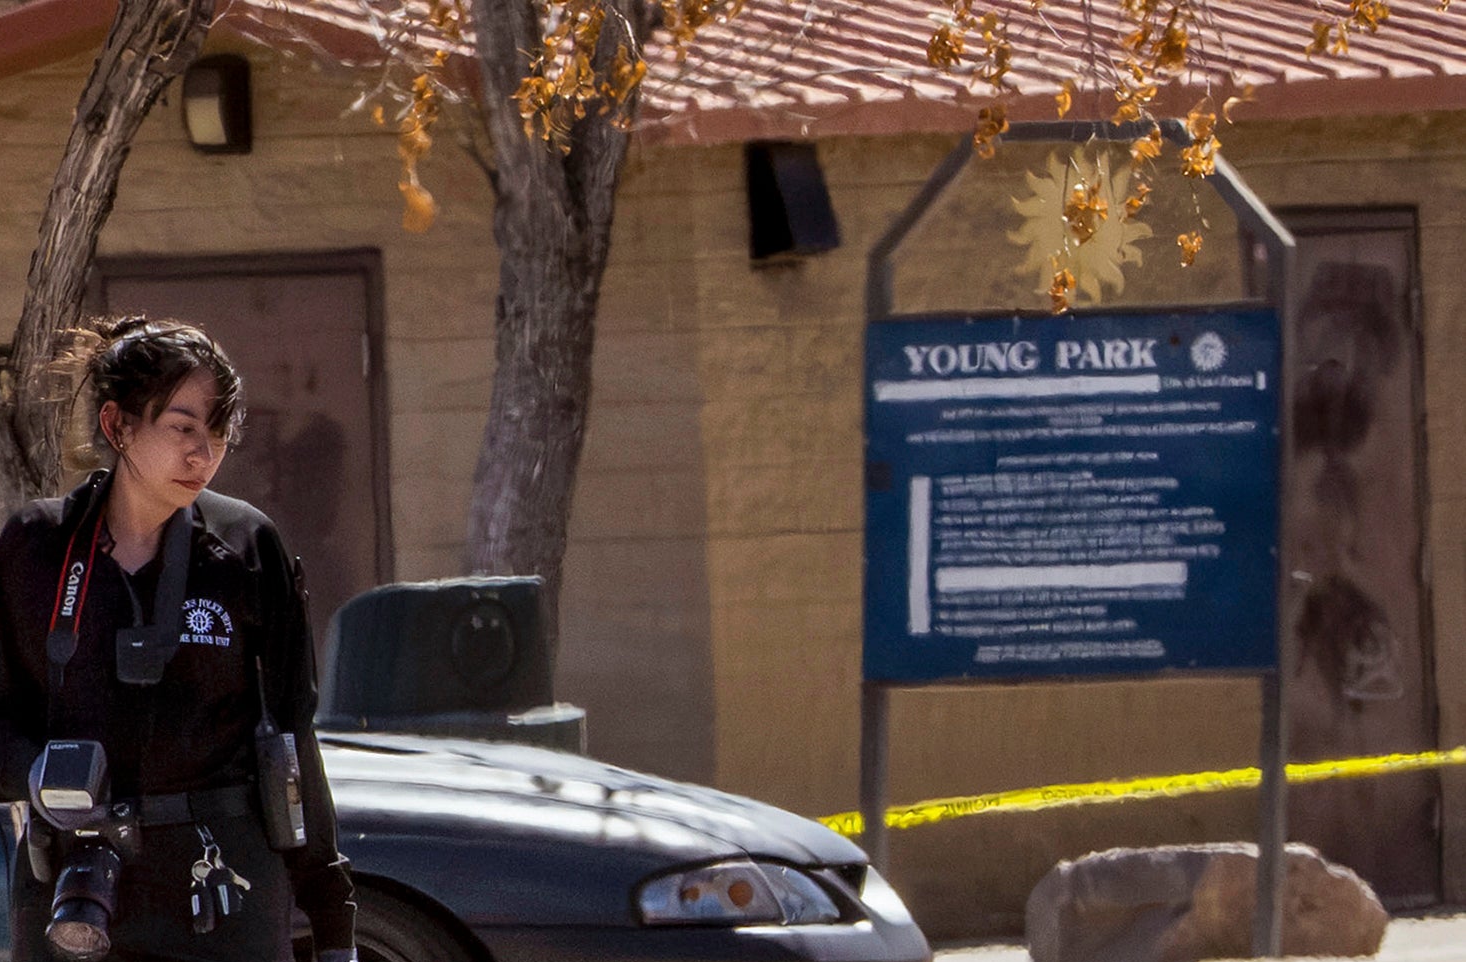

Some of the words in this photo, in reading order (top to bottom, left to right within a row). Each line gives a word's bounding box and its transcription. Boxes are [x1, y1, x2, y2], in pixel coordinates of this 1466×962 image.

[905, 341, 1039, 375] YOUNG
[1055, 338, 1158, 371] PARK
[61, 561, 85, 617] Canon
